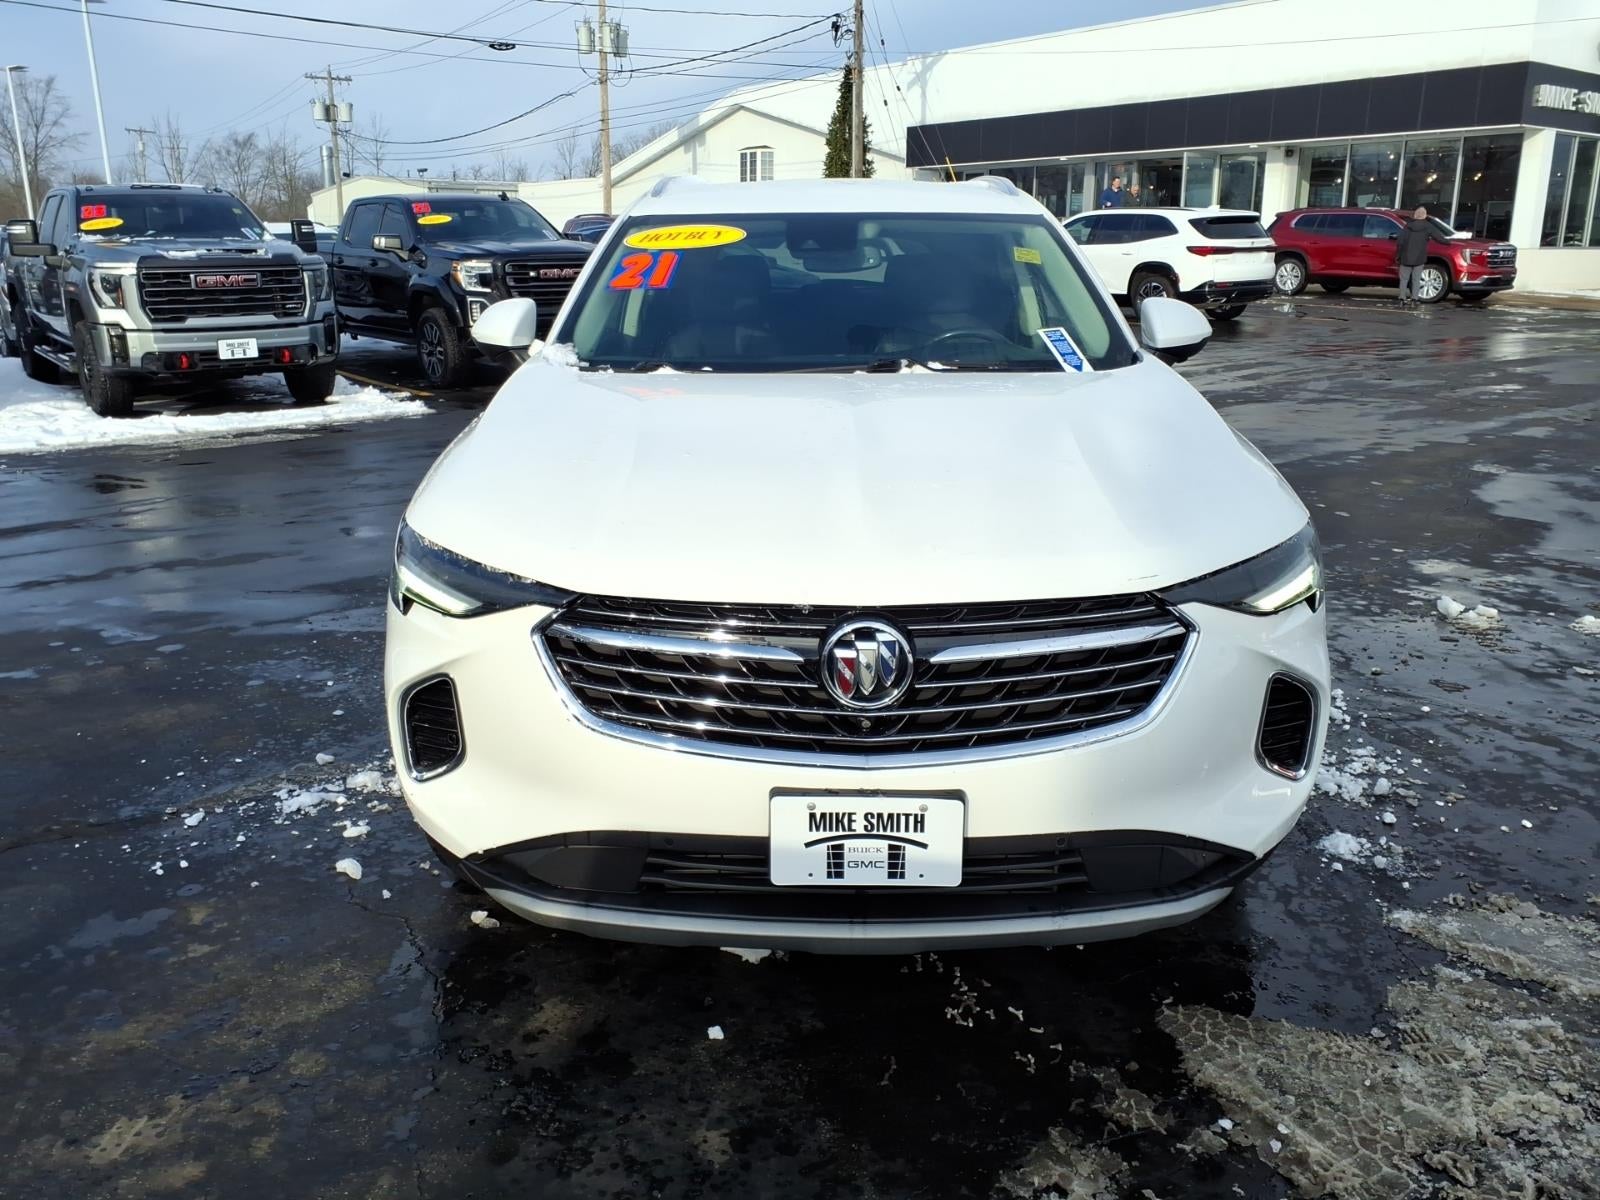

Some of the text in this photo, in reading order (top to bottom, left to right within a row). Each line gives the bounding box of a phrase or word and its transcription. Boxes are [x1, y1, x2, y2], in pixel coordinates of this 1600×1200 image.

[1536, 84, 1578, 110] MIKE
[639, 230, 729, 243] HOT BUY
[609, 251, 679, 289] 21
[196, 275, 257, 287] GMC
[808, 811, 926, 833] MIKE SMITH
[848, 846, 884, 854] BUICK
[847, 860, 885, 869] GMC
